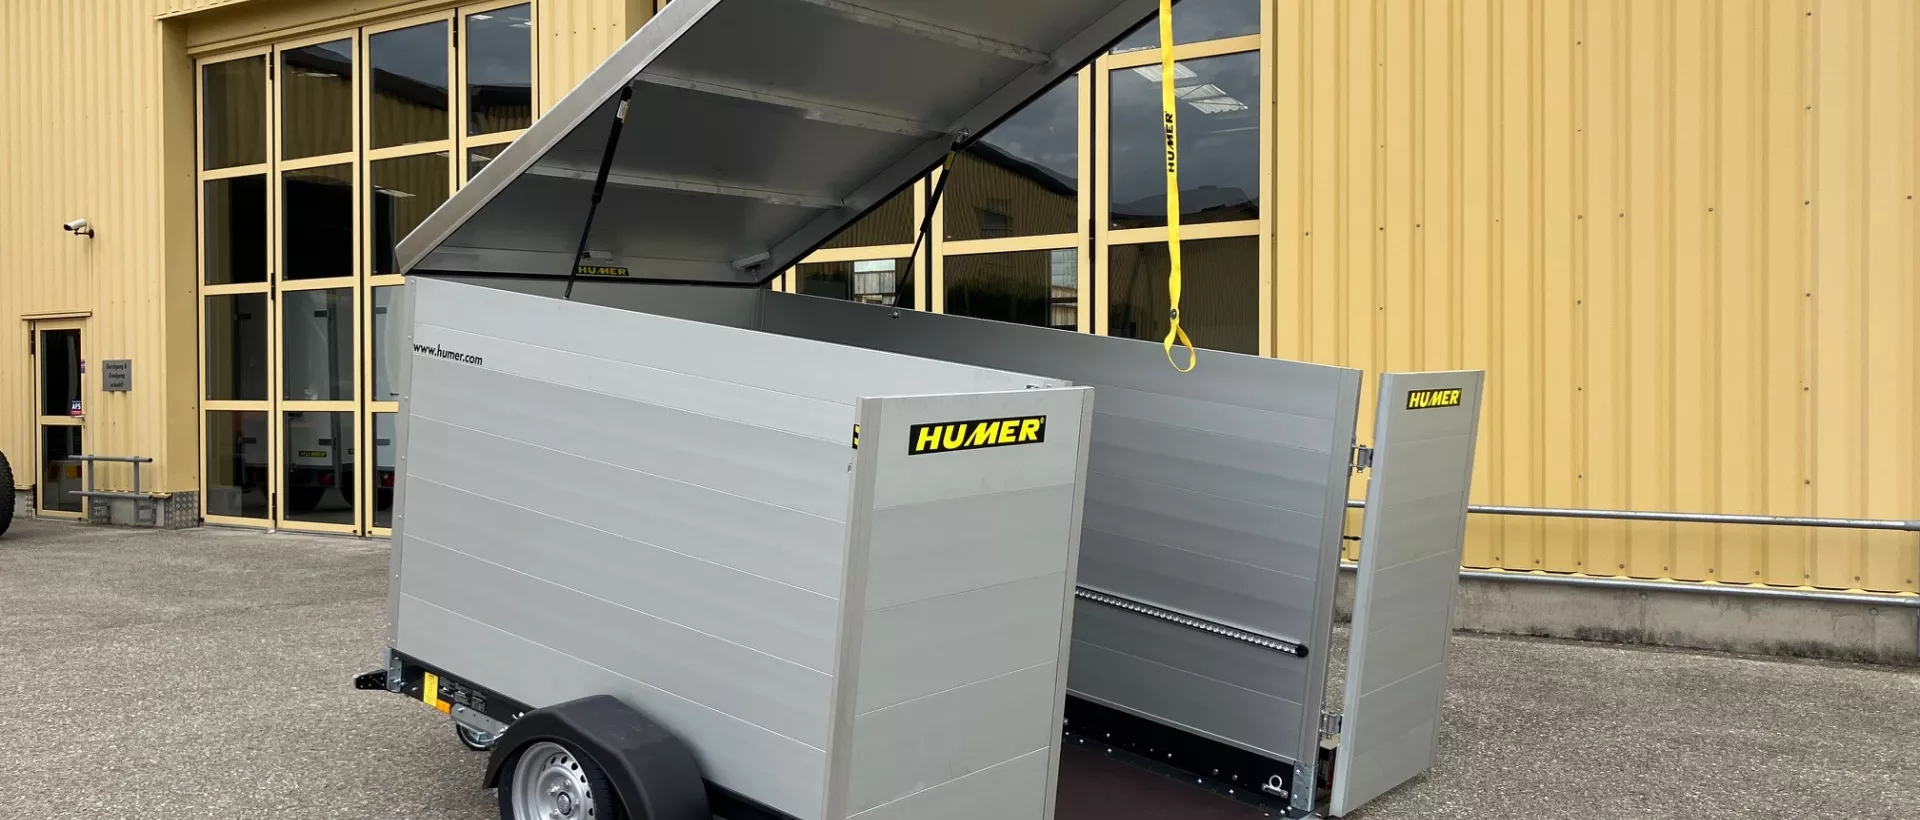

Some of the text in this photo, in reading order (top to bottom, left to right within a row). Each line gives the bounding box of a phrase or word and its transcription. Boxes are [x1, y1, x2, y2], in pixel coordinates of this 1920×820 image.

[1165, 113, 1175, 173] HUMER
[578, 266, 627, 275] HUMER
[413, 343, 483, 366] www.humer.com
[1408, 389, 1460, 408] HUMER
[916, 417, 1042, 452] HUMER
